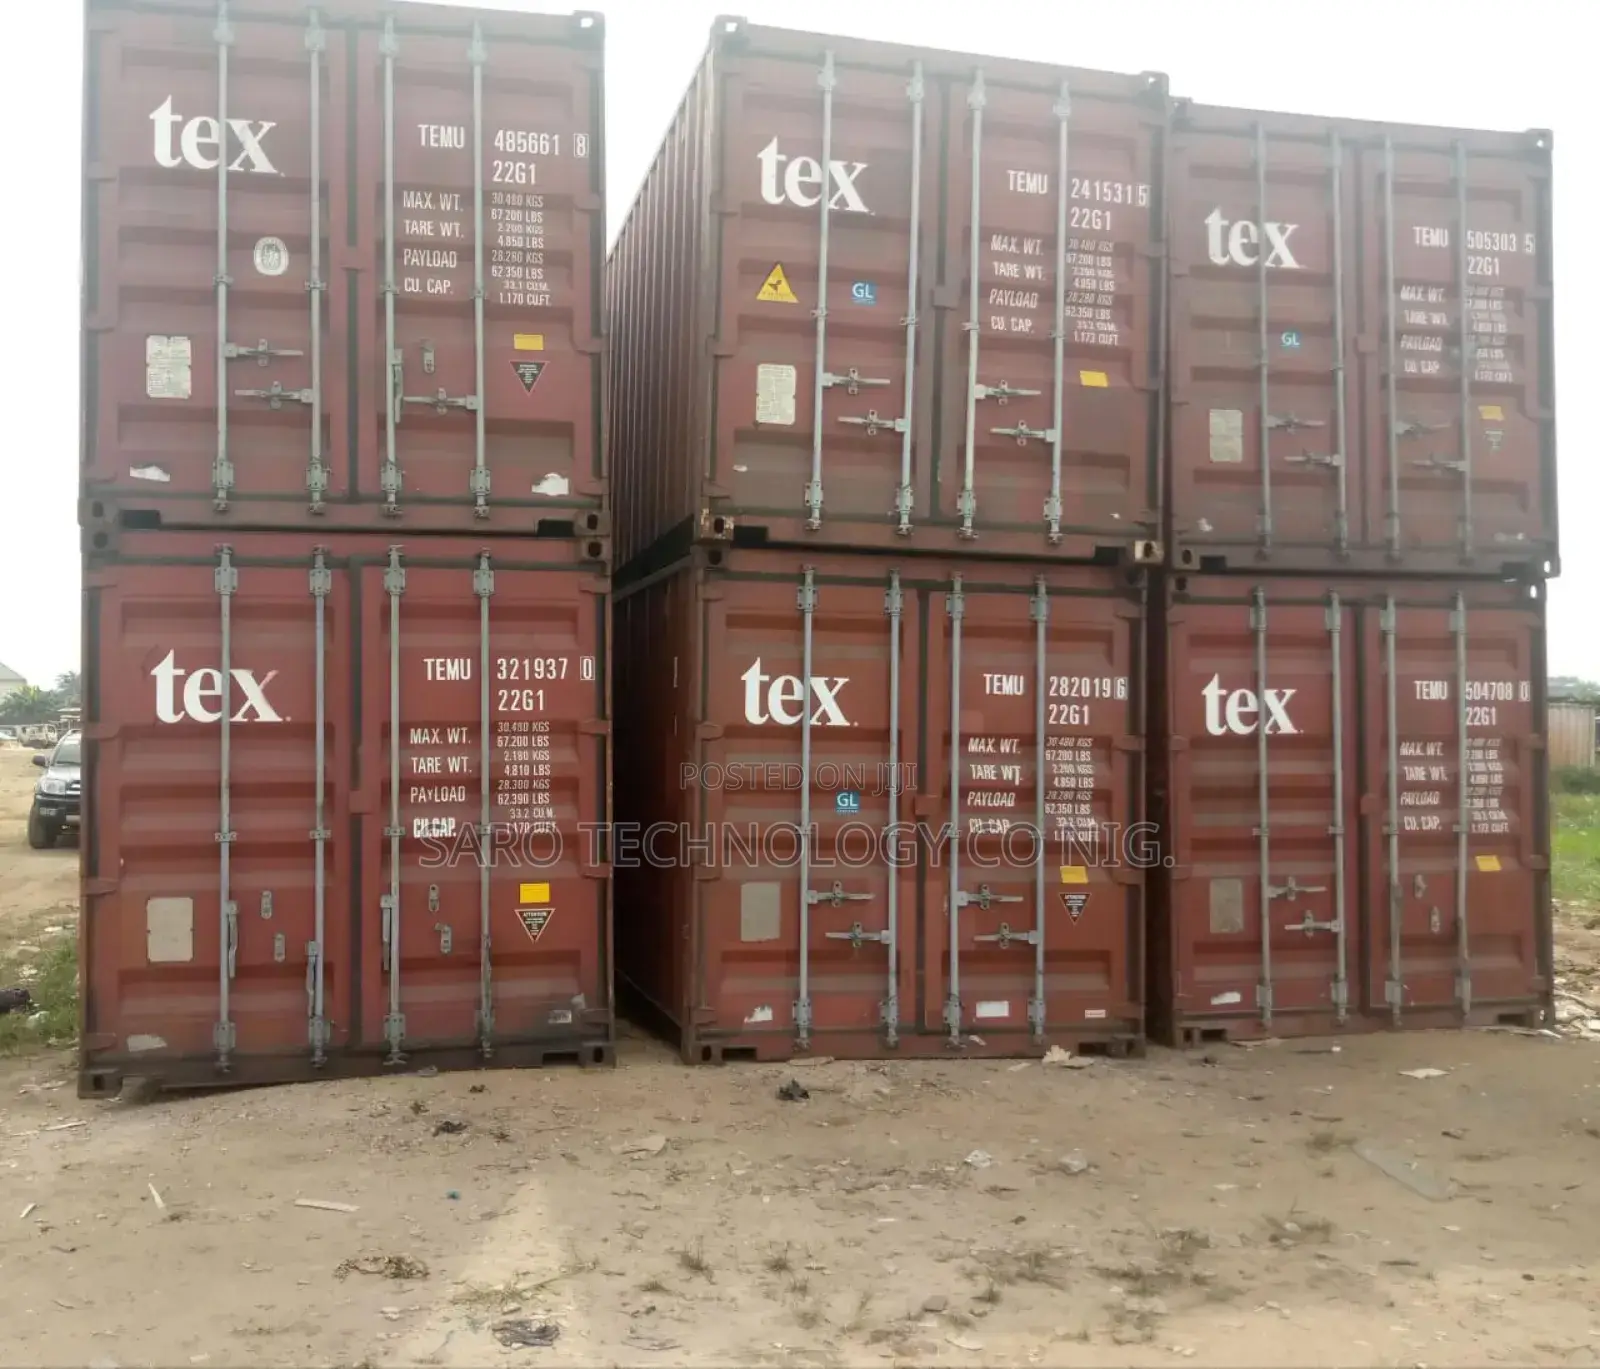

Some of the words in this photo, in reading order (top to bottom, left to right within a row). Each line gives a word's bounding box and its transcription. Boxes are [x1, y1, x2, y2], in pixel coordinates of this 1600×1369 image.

[418, 124, 465, 149] TEMU
[494, 129, 560, 155] 485661
[574, 133, 589, 157] 8
[493, 160, 536, 185] 22G1
[1007, 170, 1048, 194] TEMU
[1071, 178, 1132, 204] 241531
[403, 190, 435, 210] MAX.
[439, 191, 463, 212] WT.
[525, 195, 544, 208] KGS
[526, 210, 543, 223] LBS
[1071, 207, 1111, 231] 22G1
[404, 220, 434, 236] TARE
[440, 222, 464, 238] WT.
[526, 236, 544, 248] LBS
[991, 234, 1020, 254] MAX.
[1023, 238, 1044, 256] WT.
[1413, 226, 1449, 247] TEMU
[1467, 230, 1517, 252] 505303
[403, 249, 457, 268] PAYLOAD
[525, 251, 544, 264] KGS
[526, 267, 544, 279] LBS
[993, 261, 1019, 278] TARE
[1024, 265, 1046, 281] WT.
[1468, 256, 1500, 276] 22G1
[852, 283, 874, 298] GL
[989, 288, 1039, 309] PAYLOAD
[1281, 333, 1300, 345] GL
[423, 658, 471, 681] TEMU
[497, 658, 568, 681] 321937
[983, 673, 1024, 696] TEMU
[1049, 676, 1111, 698] 282019
[1414, 680, 1448, 700] TEMU
[1465, 681, 1512, 700] 504708
[498, 690, 544, 711] 22G1
[1049, 704, 1089, 726] 22G1
[1466, 707, 1496, 725] 22G1
[532, 721, 550, 732] KGS
[410, 728, 443, 744] MAX.
[447, 727, 471, 744] WT.
[497, 735, 528, 747] 67.200
[532, 735, 550, 747] LBS
[968, 737, 996, 753] MAX.
[1000, 738, 1020, 753] WT.
[532, 750, 550, 761] KGS
[1075, 751, 1091, 761] LBS
[411, 757, 441, 773] TARE
[447, 756, 472, 773] WT.
[533, 764, 551, 776] LBS
[970, 764, 997, 780] TARE
[533, 779, 550, 790] KGS
[1078, 777, 1094, 788] LBS
[410, 786, 466, 803] PAYLOAD
[532, 793, 550, 805] LBS
[837, 793, 858, 807] GL
[967, 791, 1016, 807] PAYLOAD
[509, 808, 529, 819] 33.2
[1075, 804, 1090, 814] LBS
